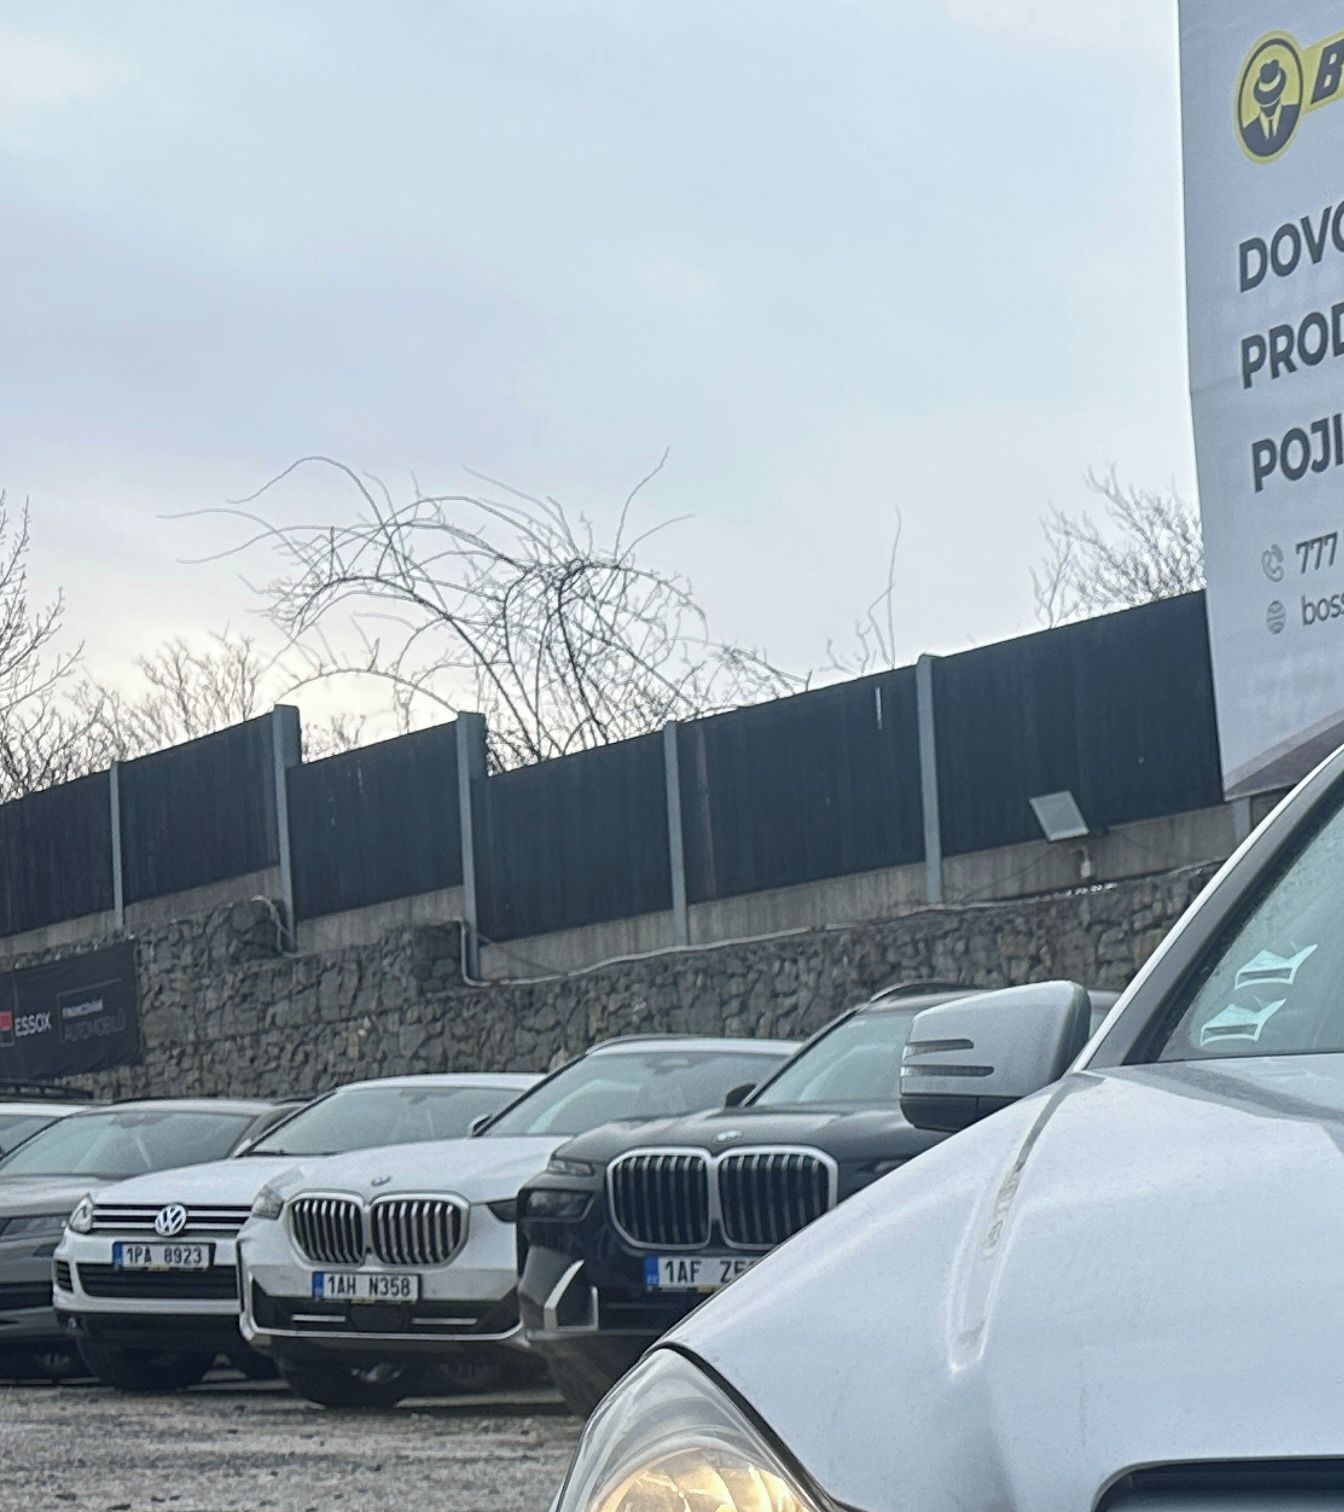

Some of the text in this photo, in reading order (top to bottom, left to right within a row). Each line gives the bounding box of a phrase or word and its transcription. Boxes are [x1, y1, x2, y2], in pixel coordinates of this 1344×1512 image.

[1296, 532, 1338, 575] 777
[15, 1011, 52, 1037] ESSOX
[126, 1246, 152, 1264] 1PA
[664, 1261, 701, 1283] 1AF
[328, 1276, 356, 1295] 1AH
[369, 1277, 410, 1297] N358
